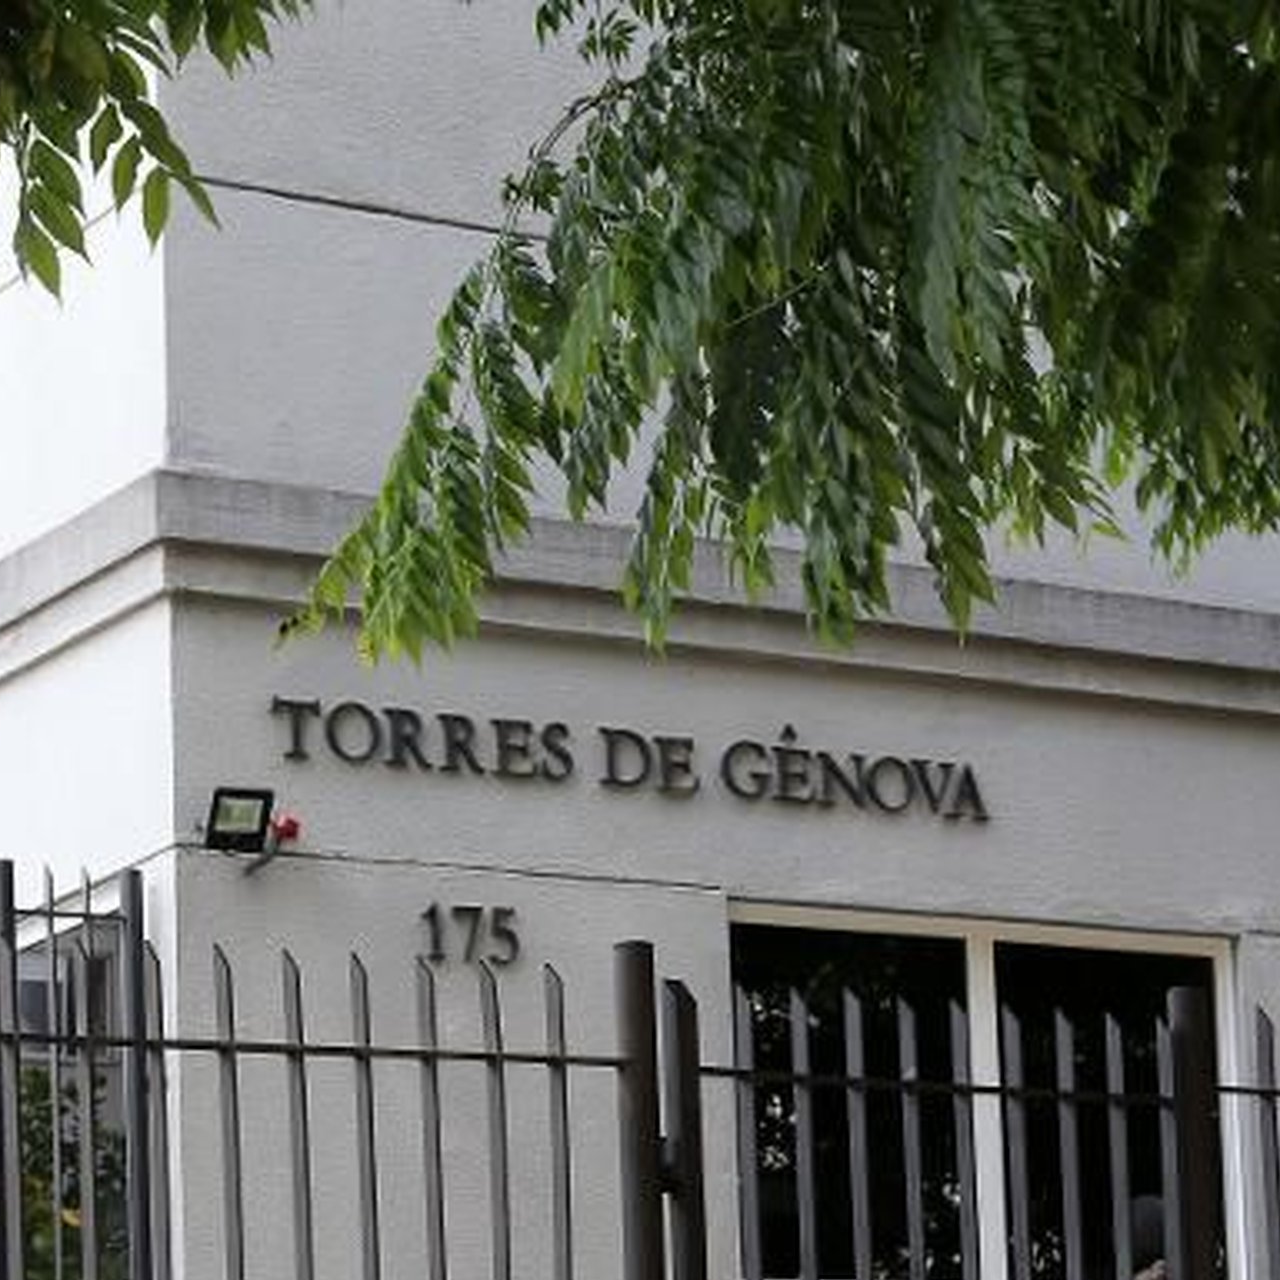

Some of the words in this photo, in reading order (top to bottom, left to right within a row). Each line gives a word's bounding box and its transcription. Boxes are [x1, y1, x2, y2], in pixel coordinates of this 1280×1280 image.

[273, 695, 575, 781] TORRES
[600, 726, 700, 795] DE
[721, 725, 990, 822] GÊNOVA
[421, 902, 521, 966] 175
